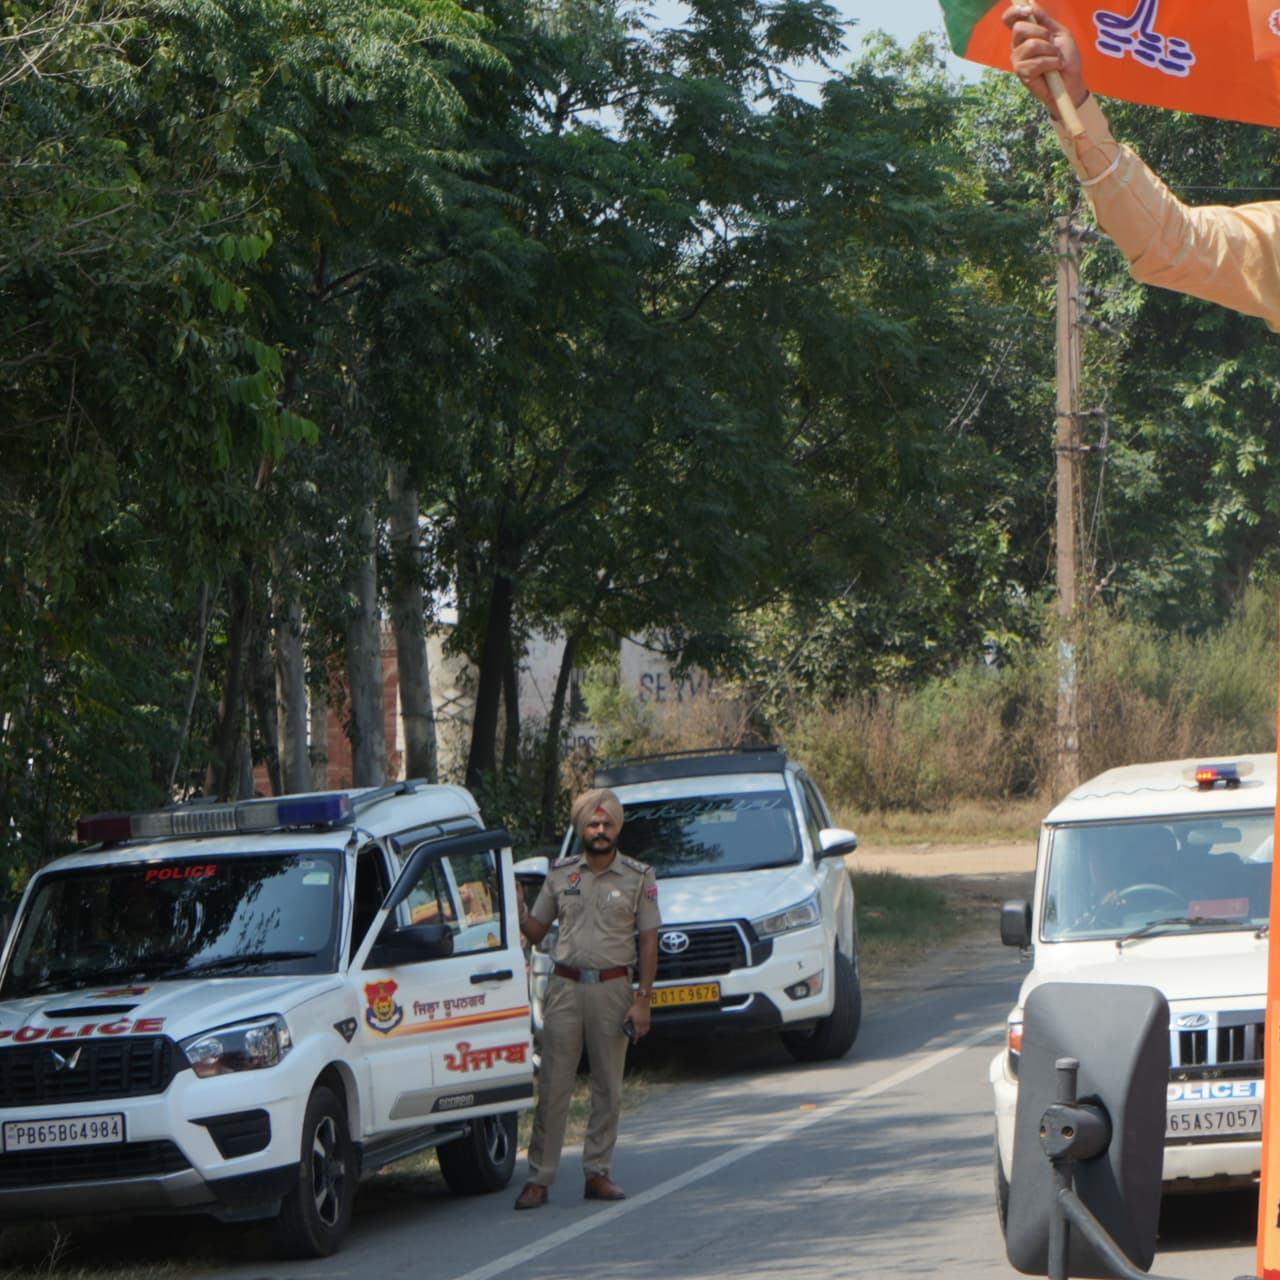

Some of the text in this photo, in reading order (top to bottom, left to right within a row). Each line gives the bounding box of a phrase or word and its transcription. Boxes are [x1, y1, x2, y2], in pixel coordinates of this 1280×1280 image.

[145, 864, 219, 882] POLICE
[443, 1041, 530, 1072] ਪੰਜਾਬ
[1166, 1081, 1255, 1102] OLICE
[1170, 1109, 1258, 1131] 65AS7057
[16, 1120, 119, 1144] PB65BG4984
